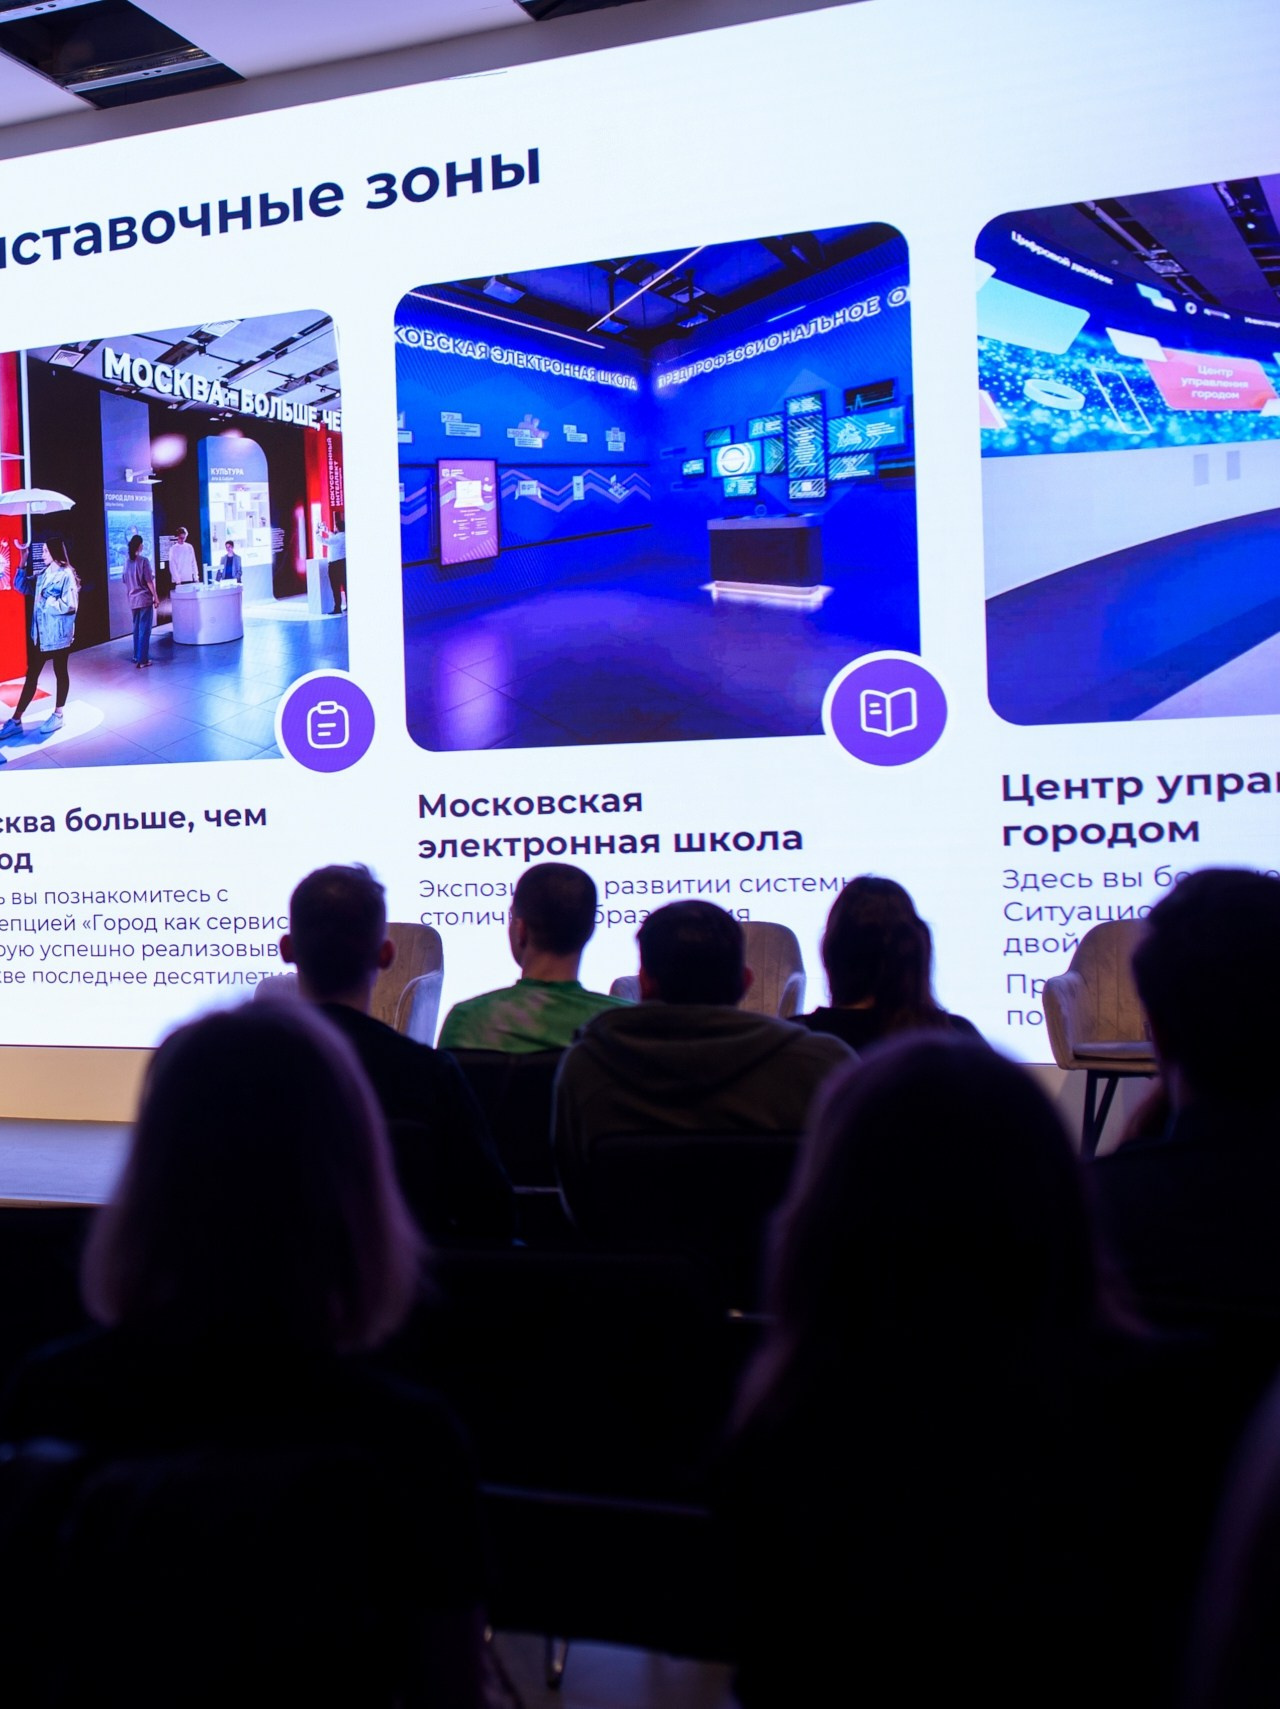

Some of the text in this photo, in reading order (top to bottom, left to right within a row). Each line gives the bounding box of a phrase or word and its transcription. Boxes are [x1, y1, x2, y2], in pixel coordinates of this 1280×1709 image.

[365, 147, 540, 210] зоны
[658, 297, 880, 388] ПРЕДПРОФЕССИОНАЛЬНОЕ
[103, 346, 223, 407] МОСКВА
[491, 346, 597, 380] ЭЛЕКТРОННАЯ
[598, 367, 637, 389] ШКОЛА
[1197, 365, 1234, 379] Центр
[1181, 377, 1249, 389] управления
[1191, 390, 1240, 401] городом
[1002, 773, 1144, 807] Центр
[418, 792, 643, 819] Московская
[65, 806, 195, 834] больше,
[203, 807, 267, 828] чем
[418, 829, 803, 863] электронная школа
[1003, 820, 1200, 853] городом
[420, 880, 514, 898] Экспоз
[604, 877, 730, 900] развитии
[1002, 869, 1093, 892] Здесь
[1103, 871, 1142, 888] вы
[11, 892, 37, 905] вы
[44, 889, 211, 905] познакомитесь
[216, 888, 229, 902] с
[82, 913, 158, 935] «Город
[164, 916, 201, 931] как
[206, 916, 289, 934] сервис
[420, 912, 512, 926] столич
[1004, 902, 1152, 926] Ситуацио
[39, 944, 135, 962] успешно
[142, 943, 279, 961] реализовыв
[1004, 932, 1080, 956] двой
[32, 970, 148, 987] последнее
[154, 969, 296, 987] десятилет
